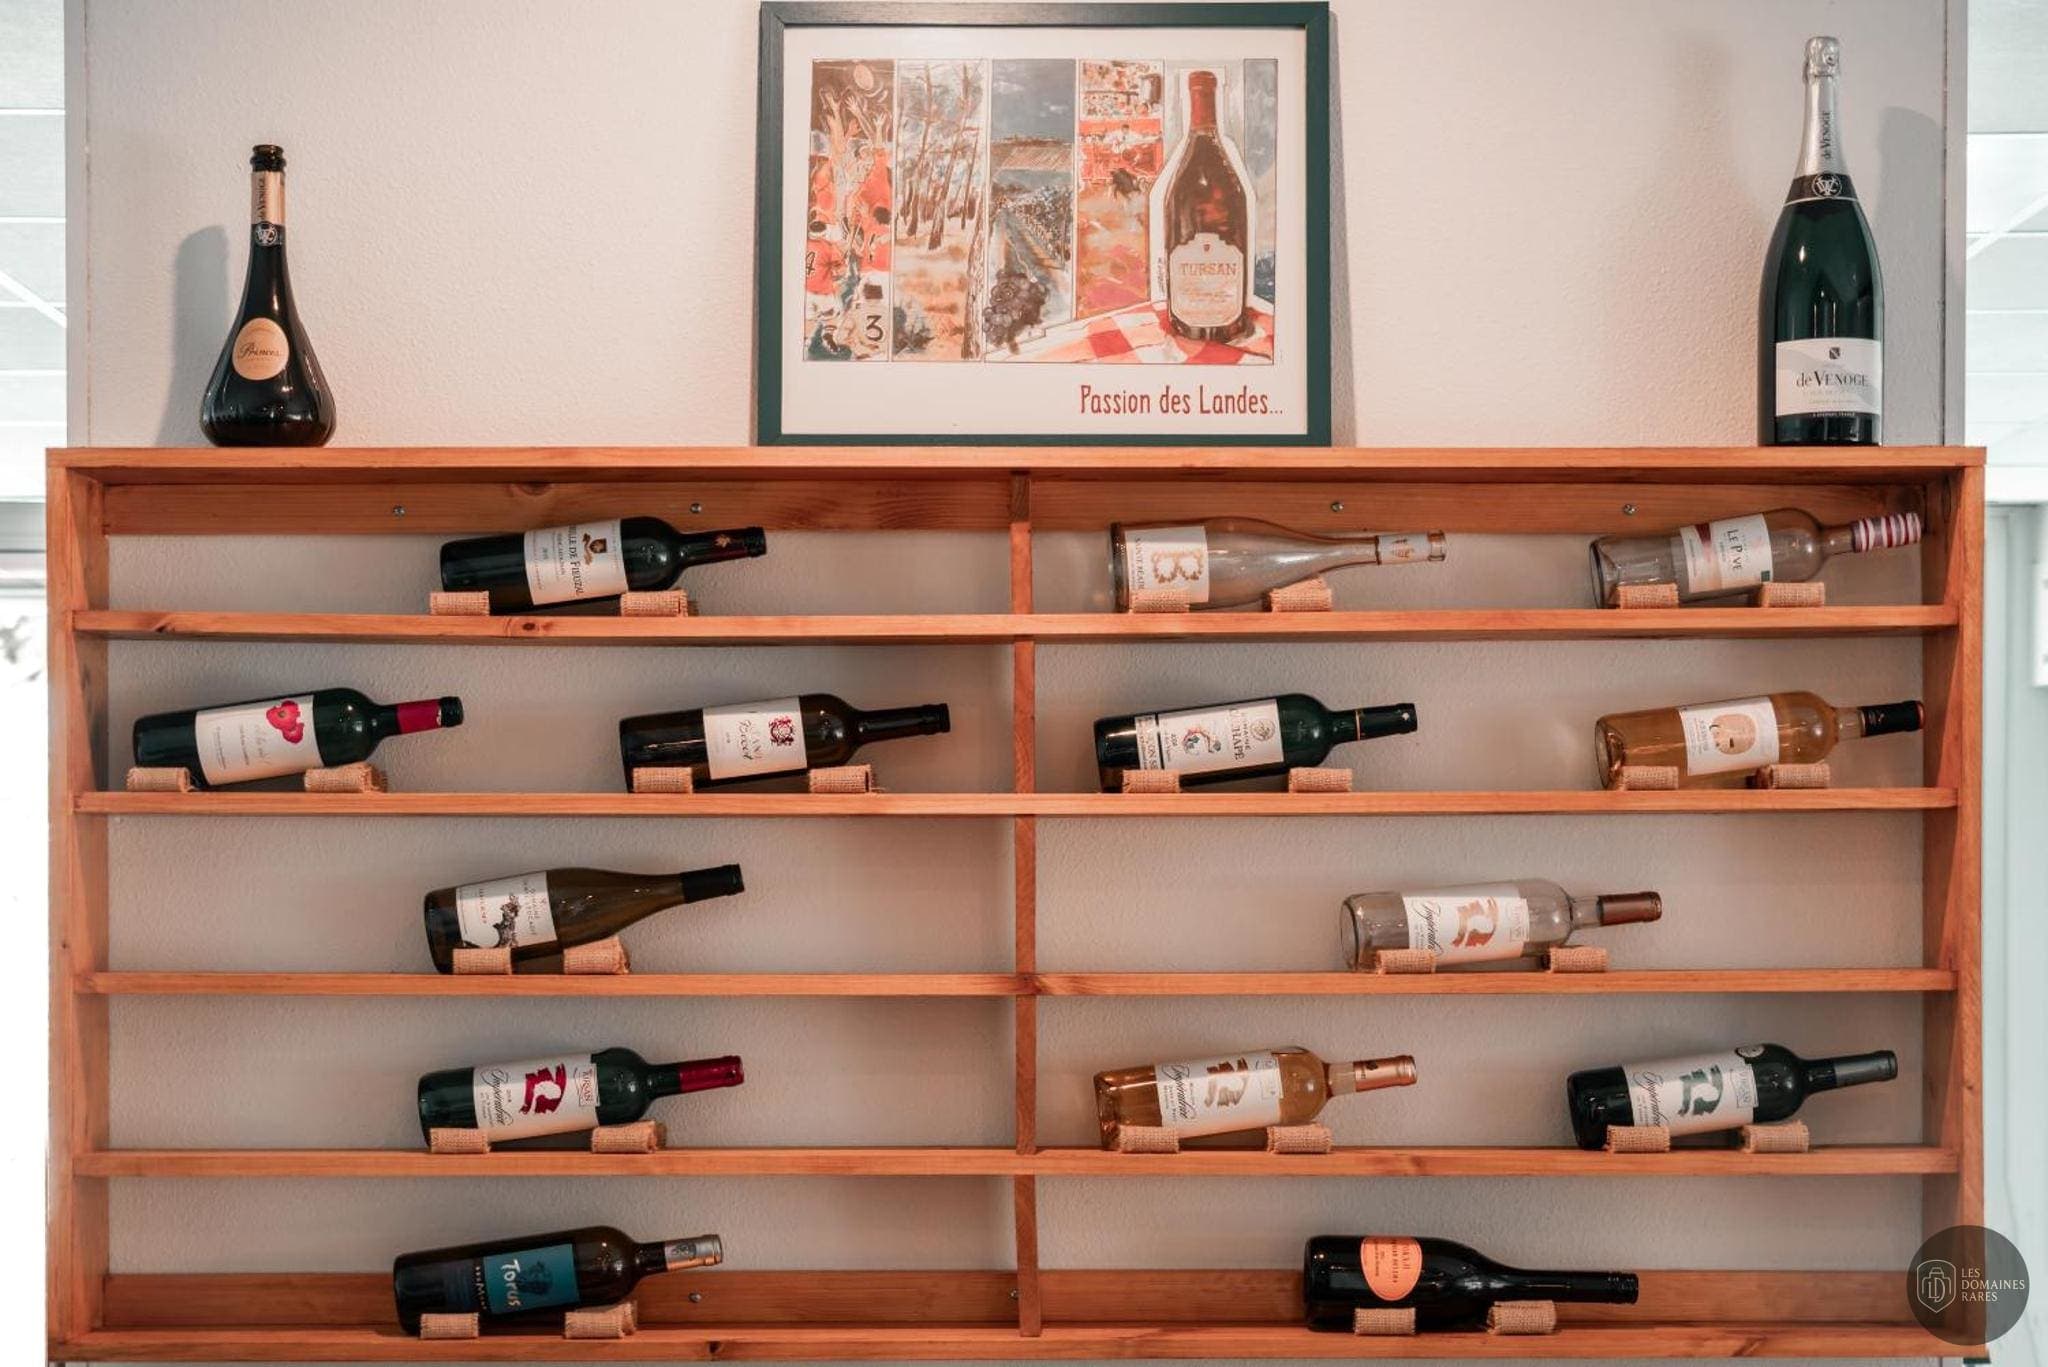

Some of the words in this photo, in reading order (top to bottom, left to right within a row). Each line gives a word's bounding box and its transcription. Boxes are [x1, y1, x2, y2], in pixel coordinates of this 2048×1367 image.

[866, 315, 884, 341] 3
[1080, 385, 1151, 414] Passion
[1159, 385, 1191, 414] des
[500, 1259, 521, 1307] Torus
